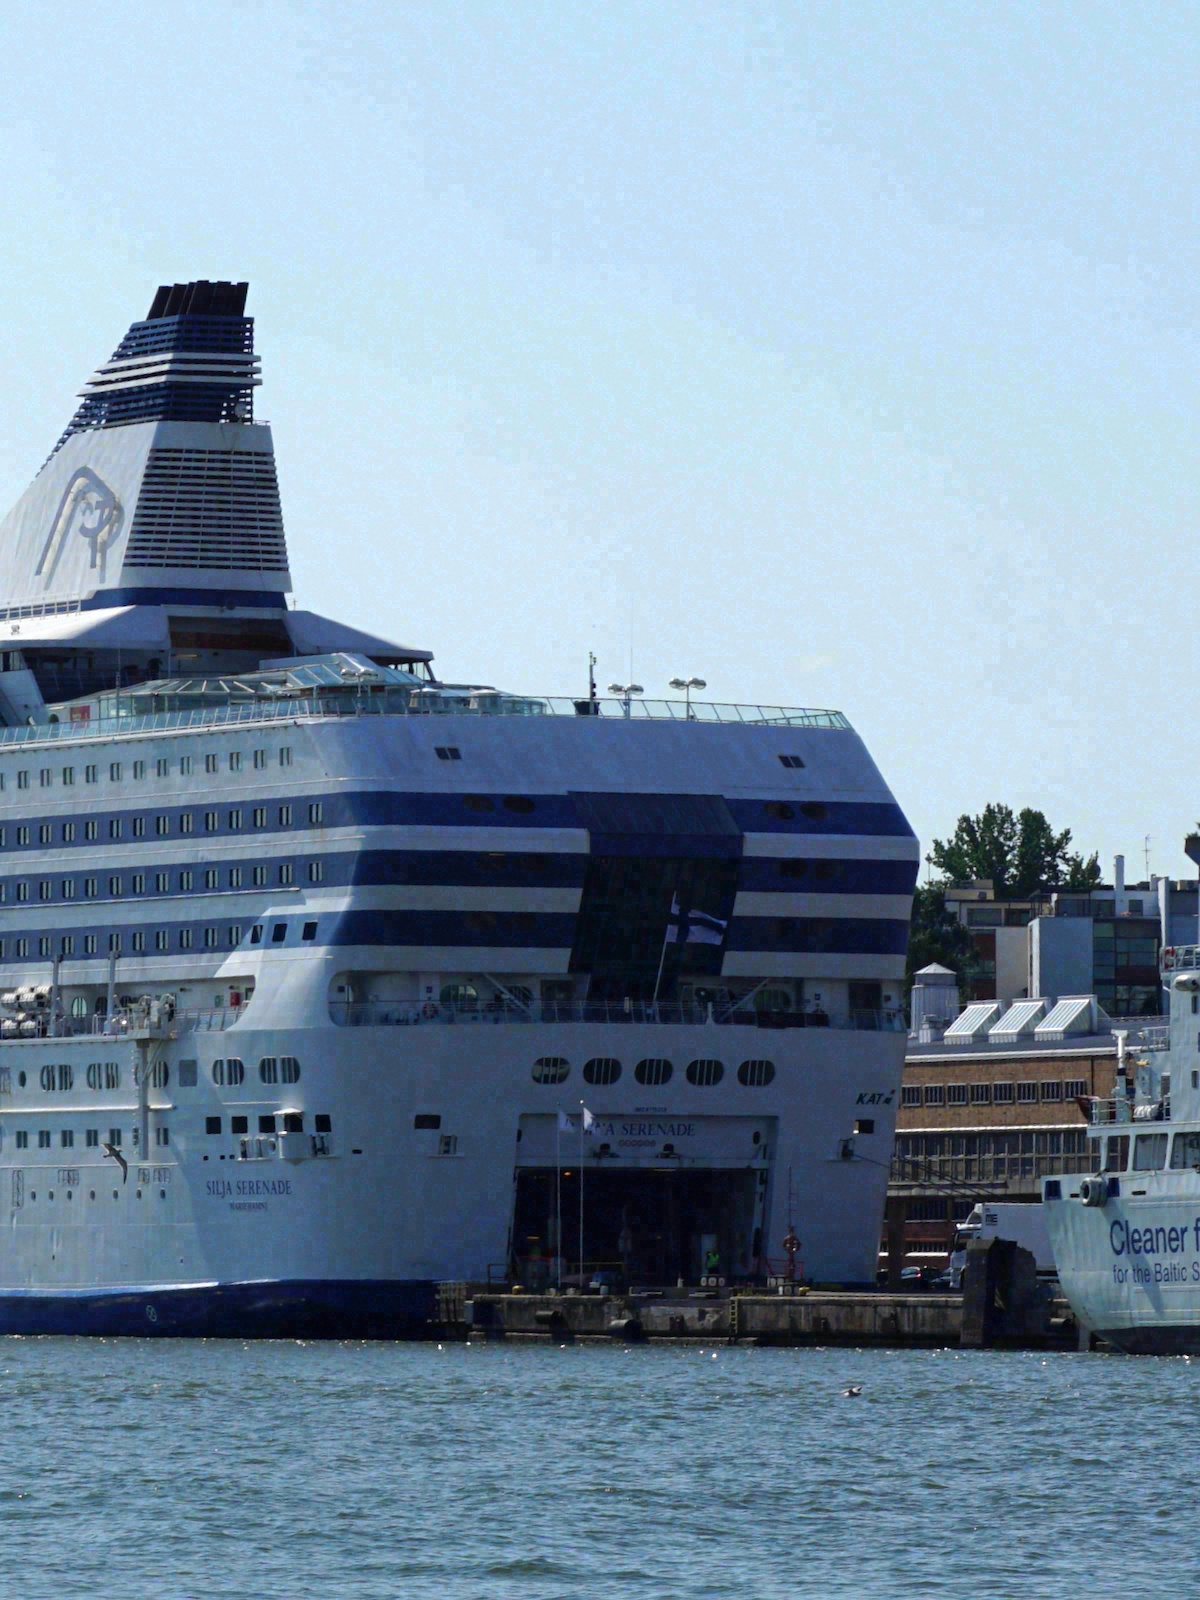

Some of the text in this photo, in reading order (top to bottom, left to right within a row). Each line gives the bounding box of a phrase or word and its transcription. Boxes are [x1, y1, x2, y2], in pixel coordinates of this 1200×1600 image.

[621, 1122, 696, 1137] SERENADE
[206, 1180, 292, 1199] SILJA SERENADE
[1110, 1219, 1188, 1256] Cleaner
[1113, 1264, 1128, 1284] for
[1132, 1263, 1151, 1283] the
[1154, 1261, 1187, 1283] Baltic
